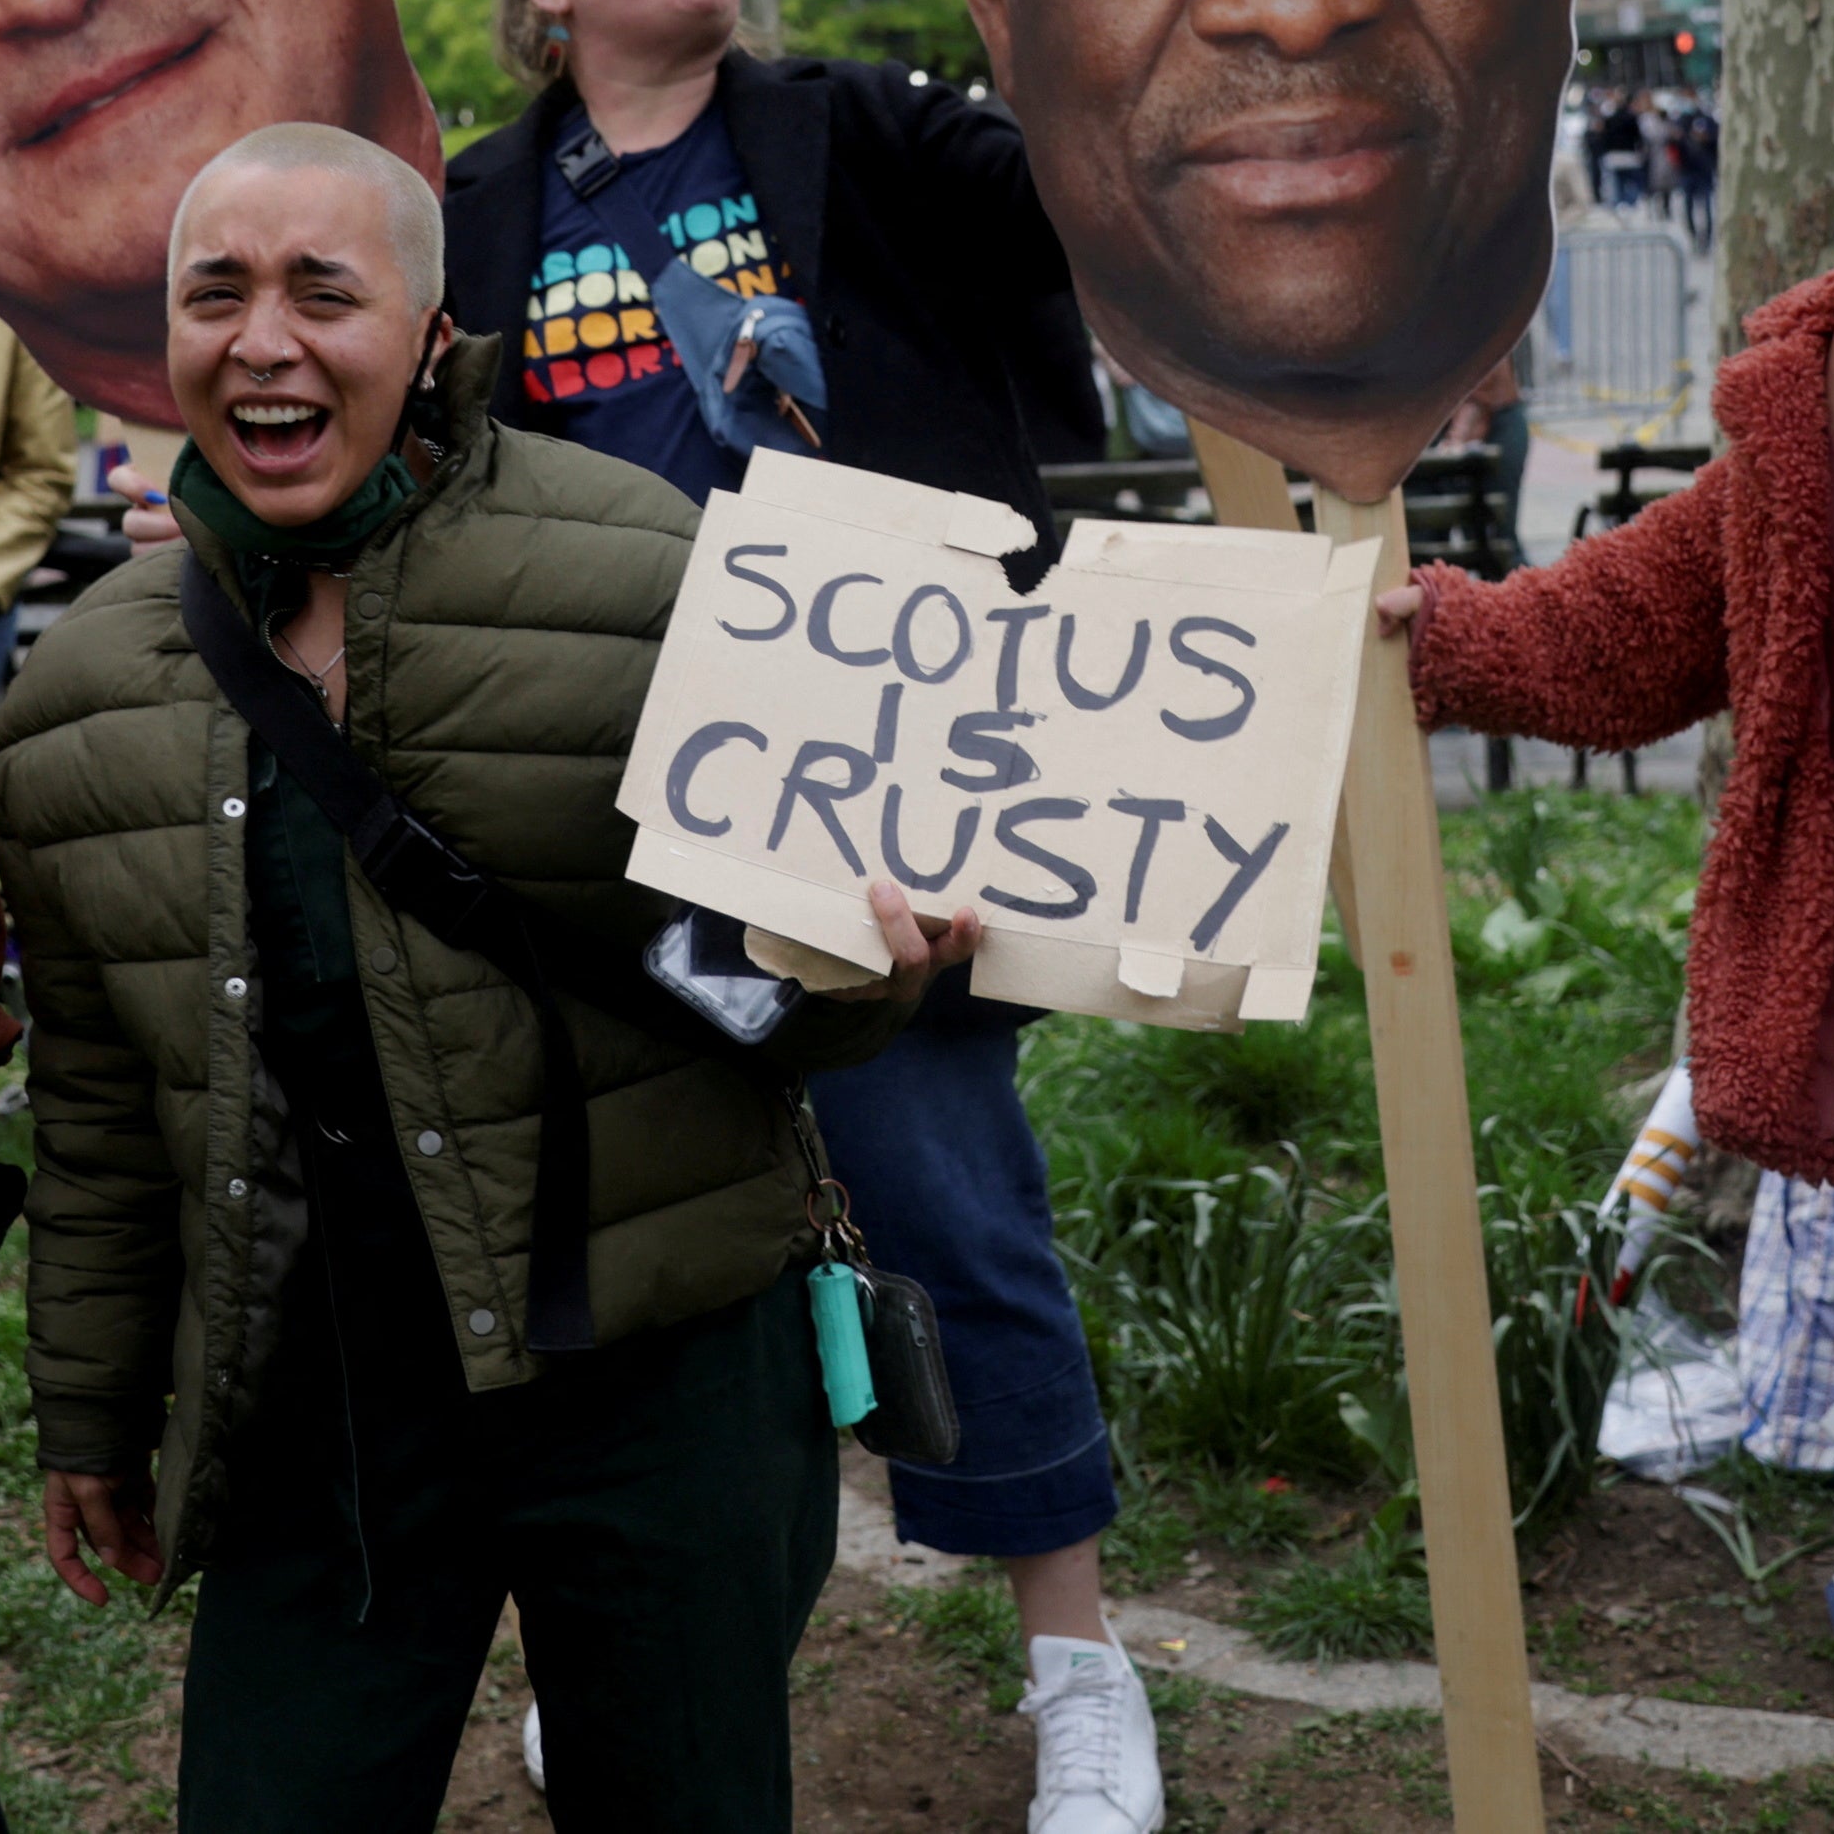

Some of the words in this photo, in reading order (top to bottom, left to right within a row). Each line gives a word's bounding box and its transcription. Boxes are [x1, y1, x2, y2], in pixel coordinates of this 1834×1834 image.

[527, 229, 768, 321] ABORON
[716, 544, 1256, 742] SCOTUS
[873, 682, 1047, 793] IS
[665, 721, 1289, 952] CRUSTY
